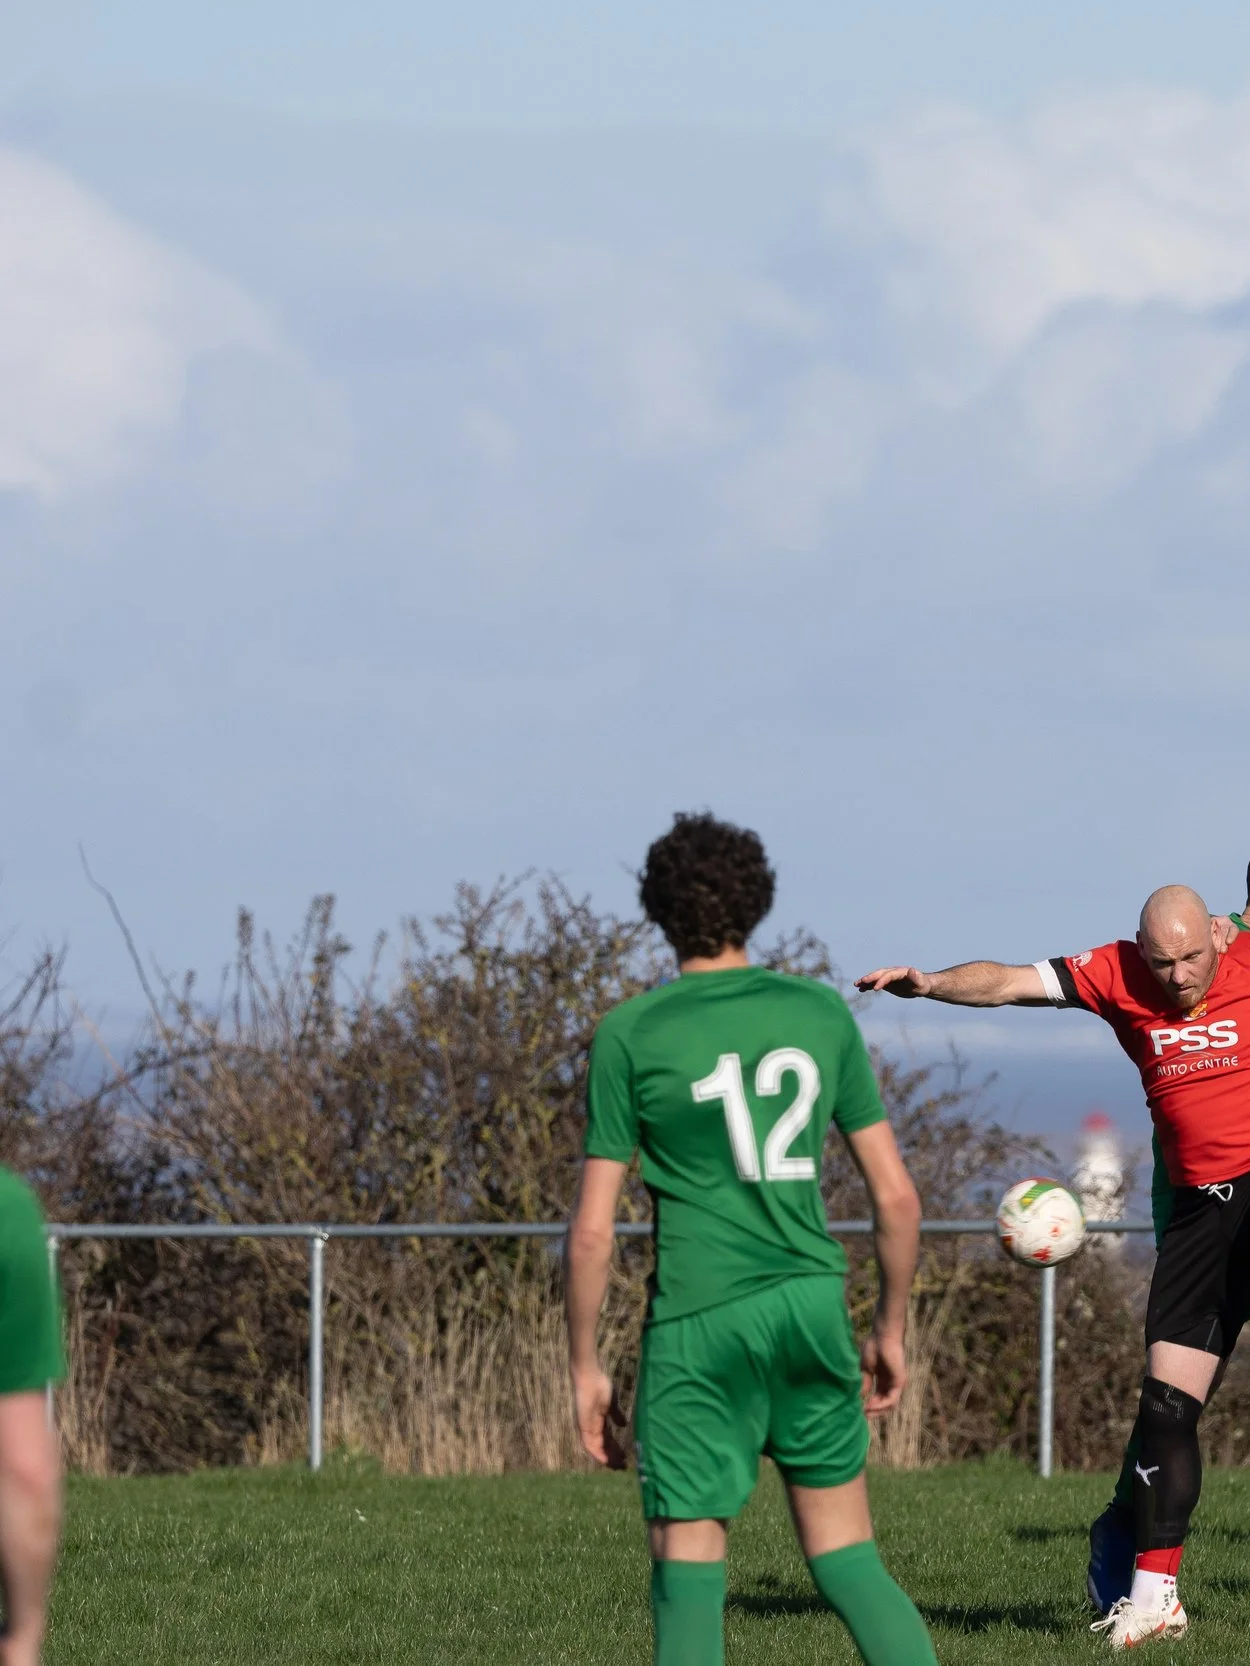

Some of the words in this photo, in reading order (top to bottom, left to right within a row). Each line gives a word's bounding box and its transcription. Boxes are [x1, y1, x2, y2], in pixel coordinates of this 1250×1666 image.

[1150, 1019, 1239, 1056] PSS
[1156, 1063, 1187, 1077] AUTO
[1189, 1055, 1238, 1072] CENTRE
[690, 1047, 821, 1182] 12
